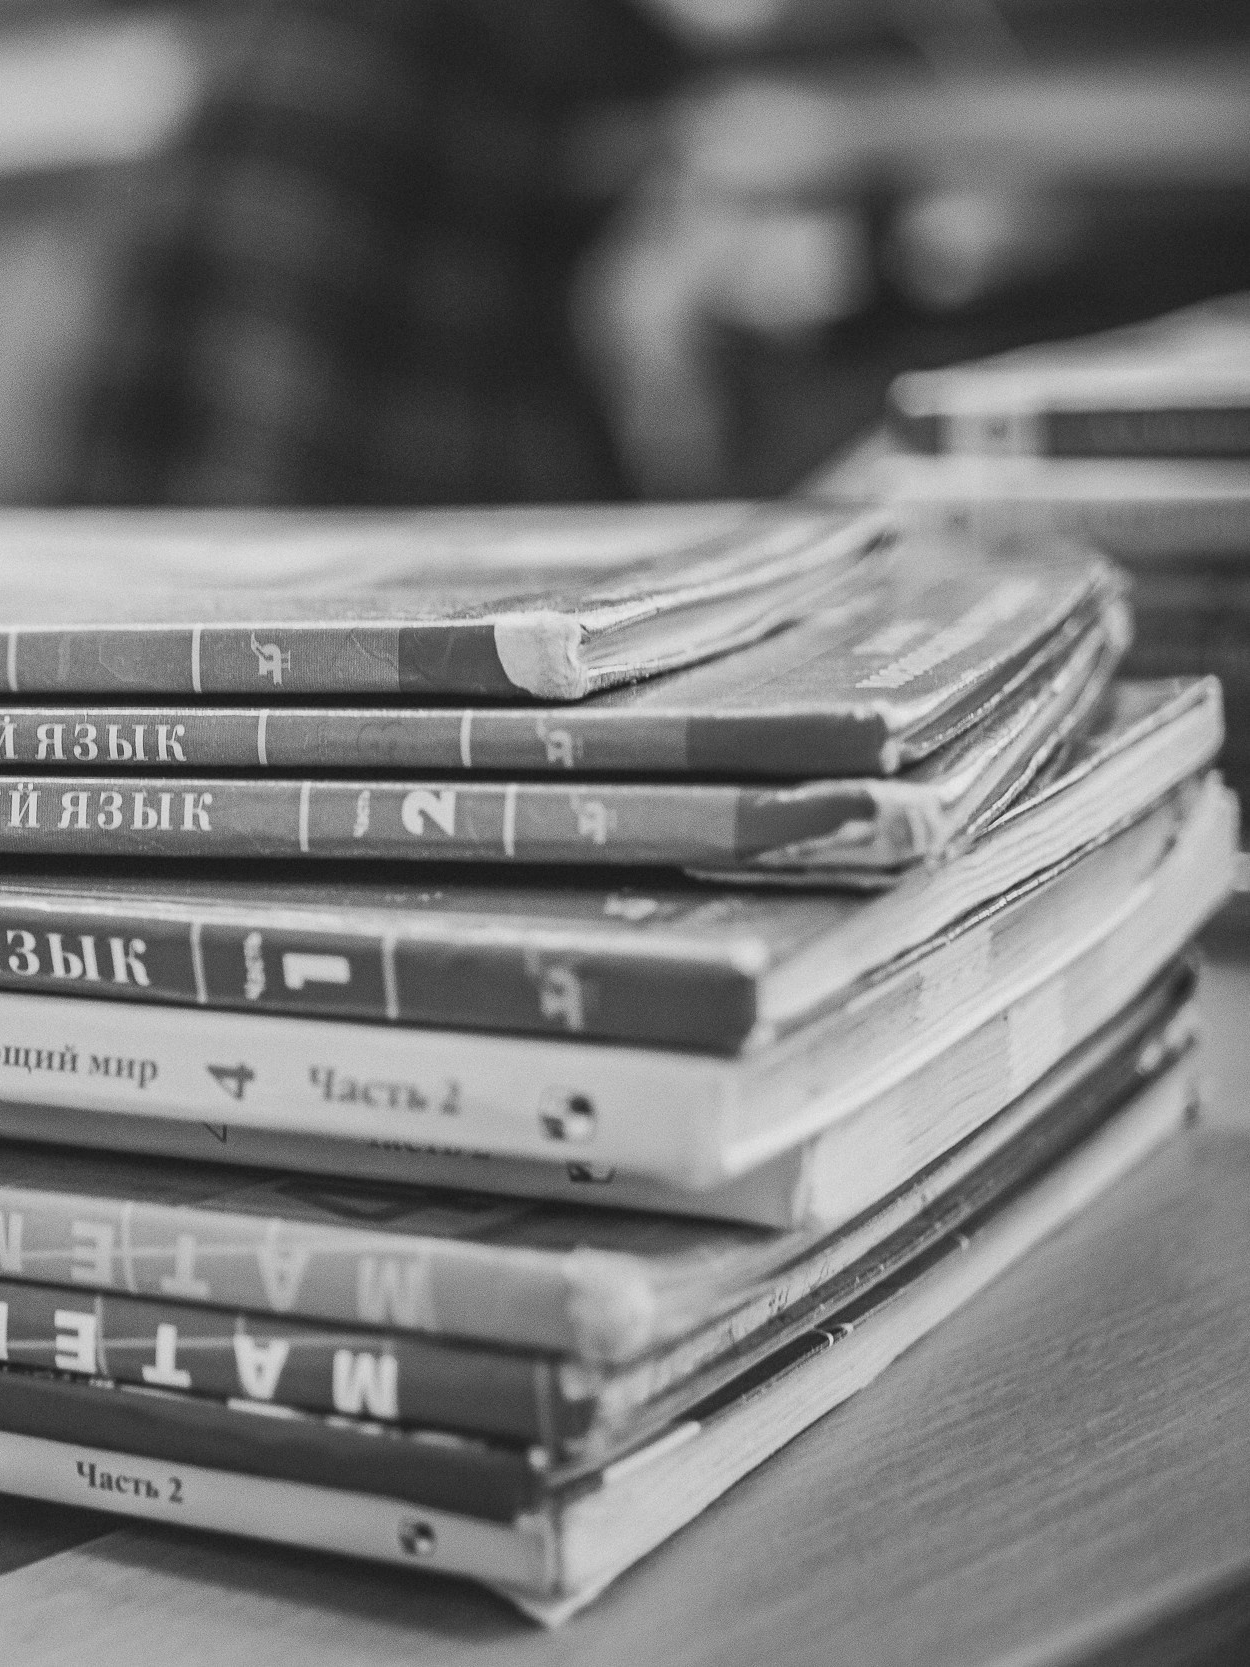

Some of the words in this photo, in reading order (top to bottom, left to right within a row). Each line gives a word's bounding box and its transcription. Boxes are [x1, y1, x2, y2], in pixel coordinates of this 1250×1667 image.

[35, 721, 189, 763] ЯЗЫК
[57, 789, 215, 833] ЯЗЫК
[400, 788, 456, 837] 2
[282, 951, 350, 991] 1
[87, 1052, 160, 1090] мир
[206, 1062, 255, 1101] 4
[309, 1064, 430, 1115] Часть
[438, 1077, 463, 1117] 2
[76, 1459, 161, 1499] Часть
[168, 1476, 185, 1504] 2
